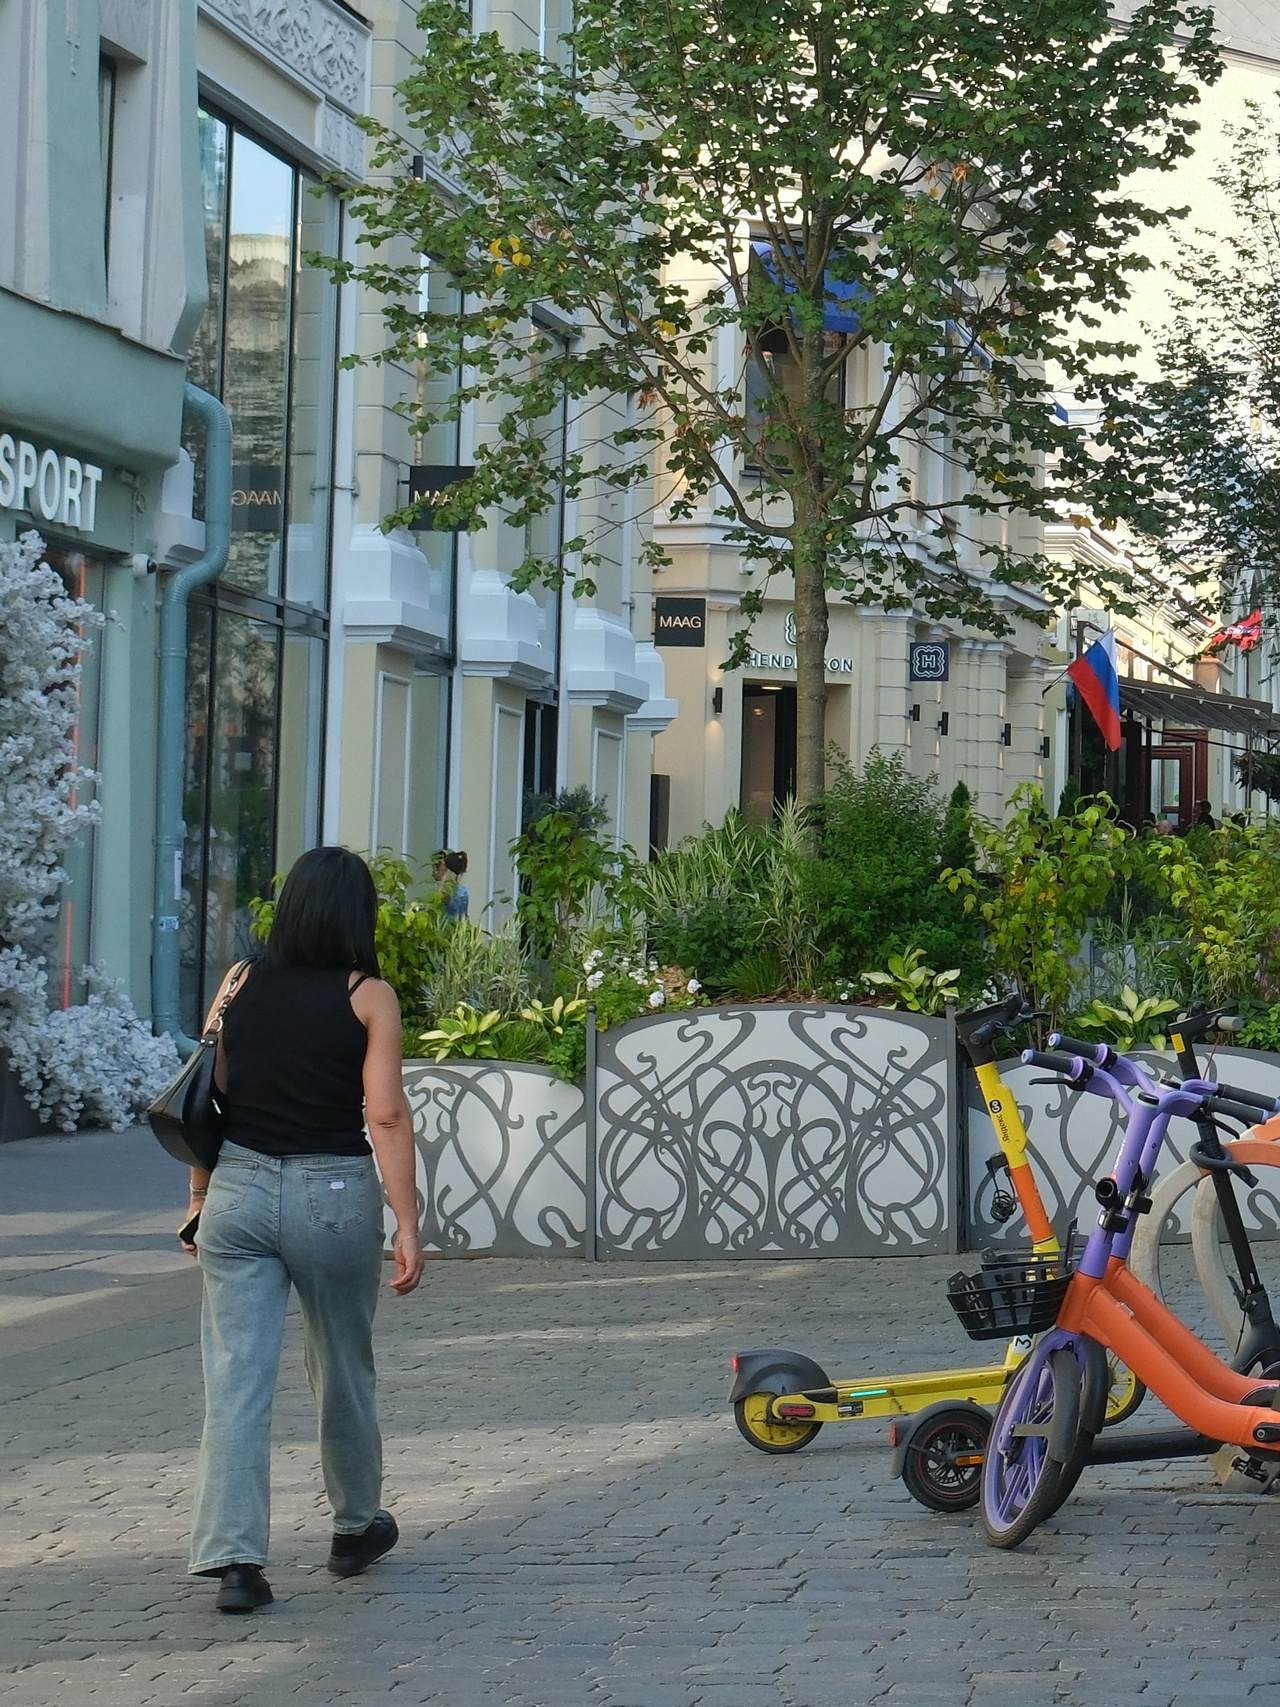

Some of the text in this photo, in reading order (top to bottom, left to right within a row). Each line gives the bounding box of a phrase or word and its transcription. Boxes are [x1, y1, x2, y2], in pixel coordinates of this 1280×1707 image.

[0, 433, 103, 532] SPORT
[660, 615, 701, 629] MAAG
[746, 653, 853, 673] HENDON
